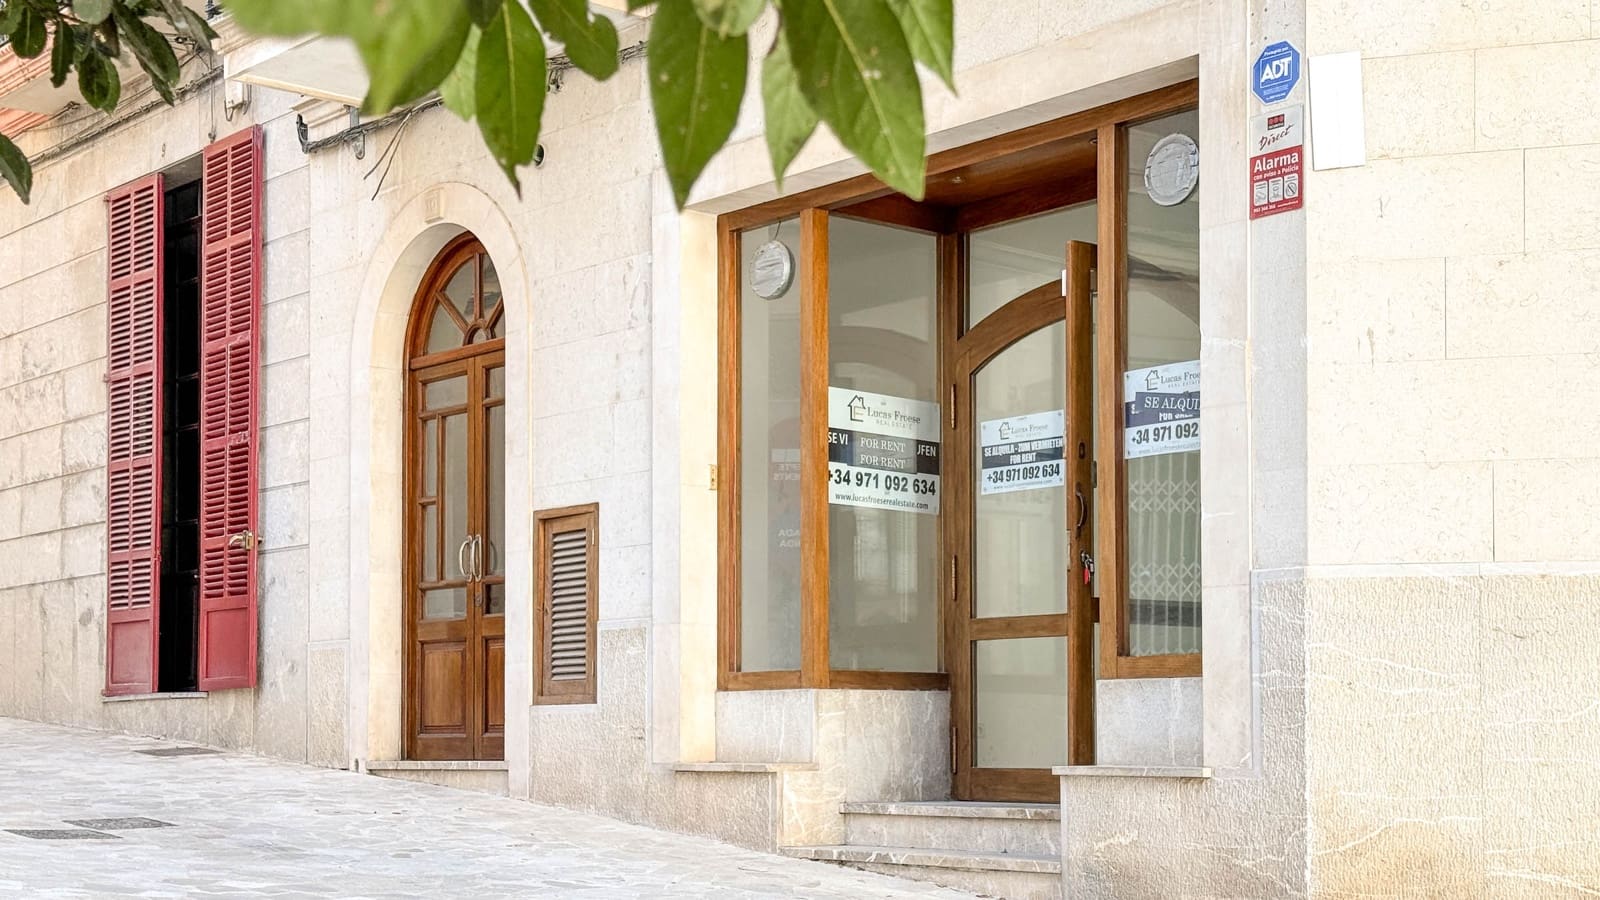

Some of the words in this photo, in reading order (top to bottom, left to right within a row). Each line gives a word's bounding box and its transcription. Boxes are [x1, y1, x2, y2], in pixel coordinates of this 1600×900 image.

[1260, 56, 1292, 82] ADT
[1259, 124, 1294, 151] Direct
[1254, 153, 1299, 173] Alarma
[1254, 173, 1263, 181] con
[1160, 374, 1182, 384] Lucas
[1144, 396, 1160, 409] SE
[1161, 396, 1200, 412] ALQUI
[867, 406, 892, 419] Lucas
[894, 410, 921, 424] Froese
[828, 431, 838, 444] SE
[1131, 428, 1150, 444] +34
[1153, 425, 1172, 442] 971
[1175, 422, 1199, 439] 092
[860, 437, 879, 448] FOR
[881, 440, 906, 453] RENT
[984, 447, 992, 457] SE
[991, 443, 1015, 457] ALQUILA
[1031, 437, 1063, 451] VERMIETEN
[860, 454, 879, 465] FOR
[881, 457, 906, 469] RENT
[1009, 454, 1021, 465] FOR
[1021, 452, 1037, 464] RENT
[828, 468, 851, 486] +34
[855, 471, 879, 489] 971
[885, 474, 909, 492] 092
[913, 478, 936, 496] 634
[987, 470, 1004, 483] +34
[1006, 468, 1020, 481] 971
[1022, 465, 1040, 480] 092
[1042, 463, 1060, 478] 634
[835, 492, 929, 510] www.lucasfroeserealestate.com
